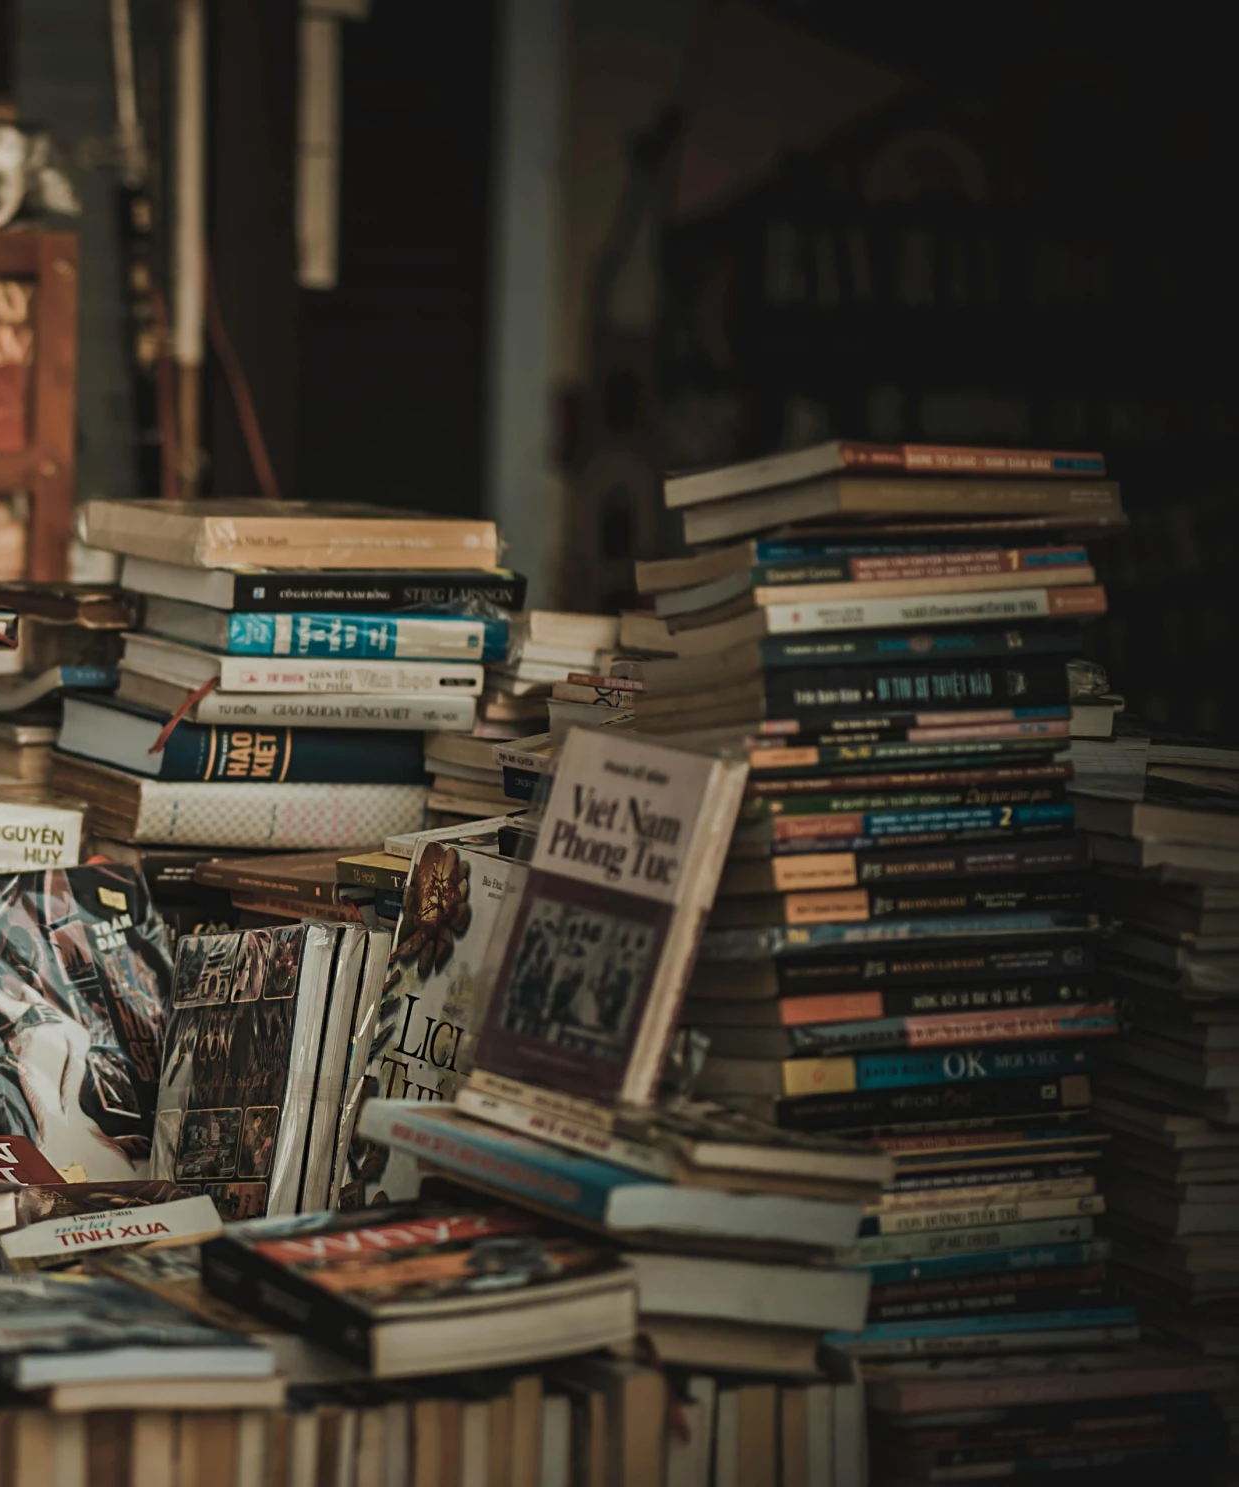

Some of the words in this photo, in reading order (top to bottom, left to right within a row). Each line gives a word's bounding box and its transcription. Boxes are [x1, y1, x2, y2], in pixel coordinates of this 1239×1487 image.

[998, 806, 1012, 828] 2
[24, 847, 62, 864] HUY
[942, 1051, 988, 1080] OK
